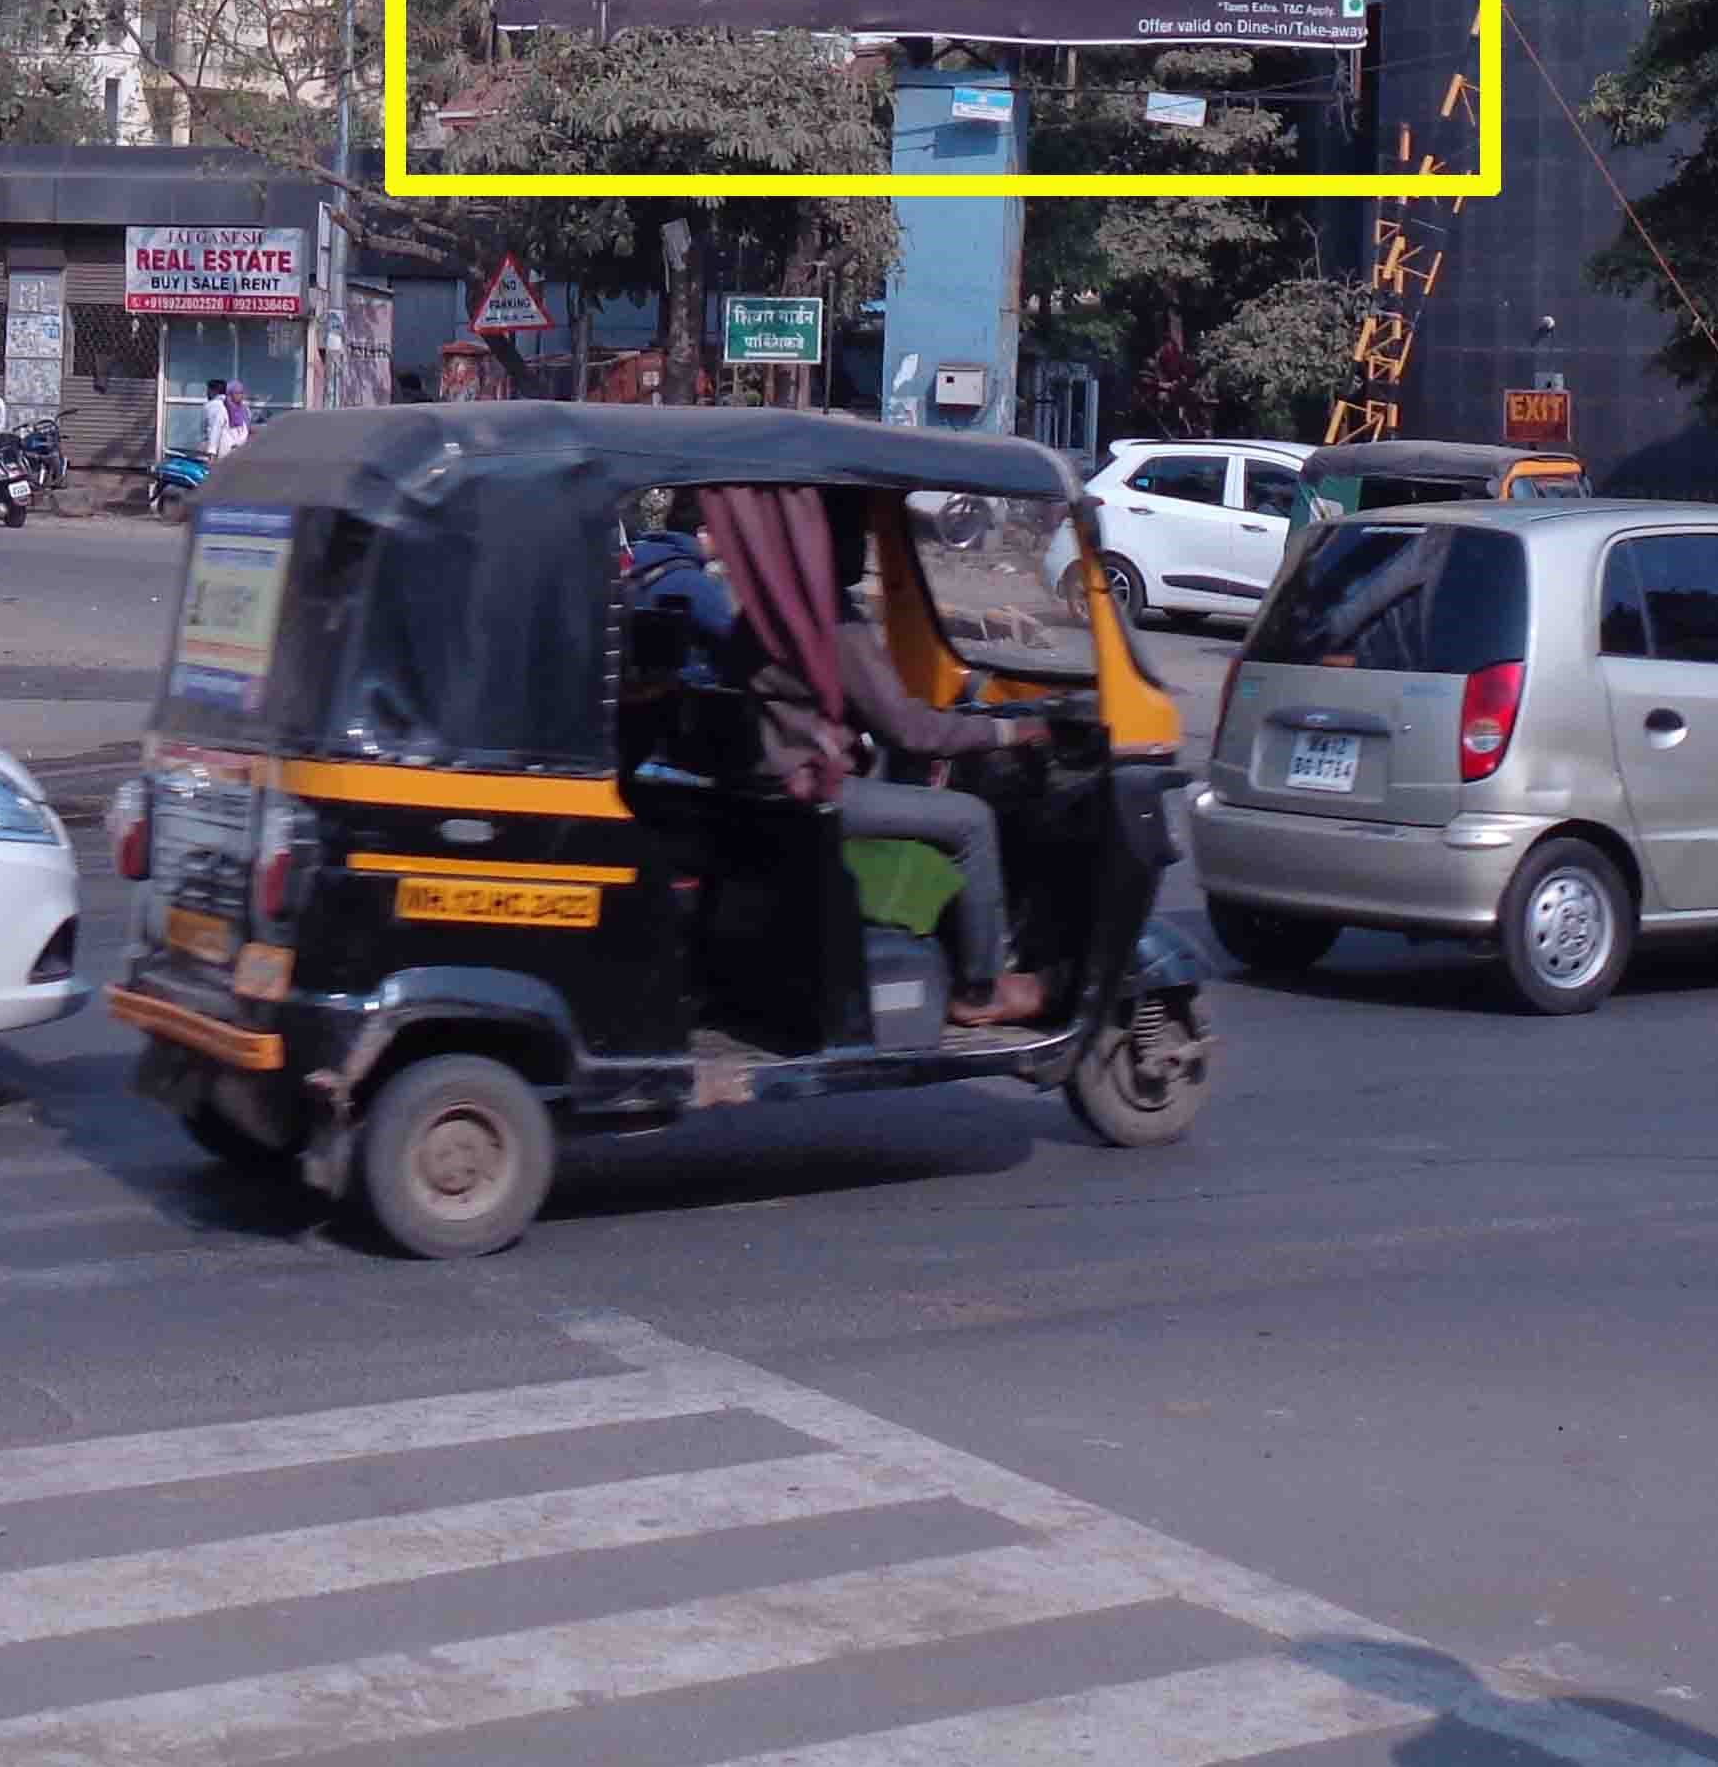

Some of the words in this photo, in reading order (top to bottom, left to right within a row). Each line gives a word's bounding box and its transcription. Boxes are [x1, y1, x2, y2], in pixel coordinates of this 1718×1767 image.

[1138, 18, 1174, 34] Offer
[1178, 18, 1211, 34] valid
[1215, 21, 1233, 34] on
[137, 249, 195, 271] REAL
[204, 250, 291, 273] ESTATE
[152, 277, 179, 289] BUY
[192, 277, 229, 290] SALE
[242, 279, 280, 291] RENT
[1509, 394, 1564, 422] EXIT
